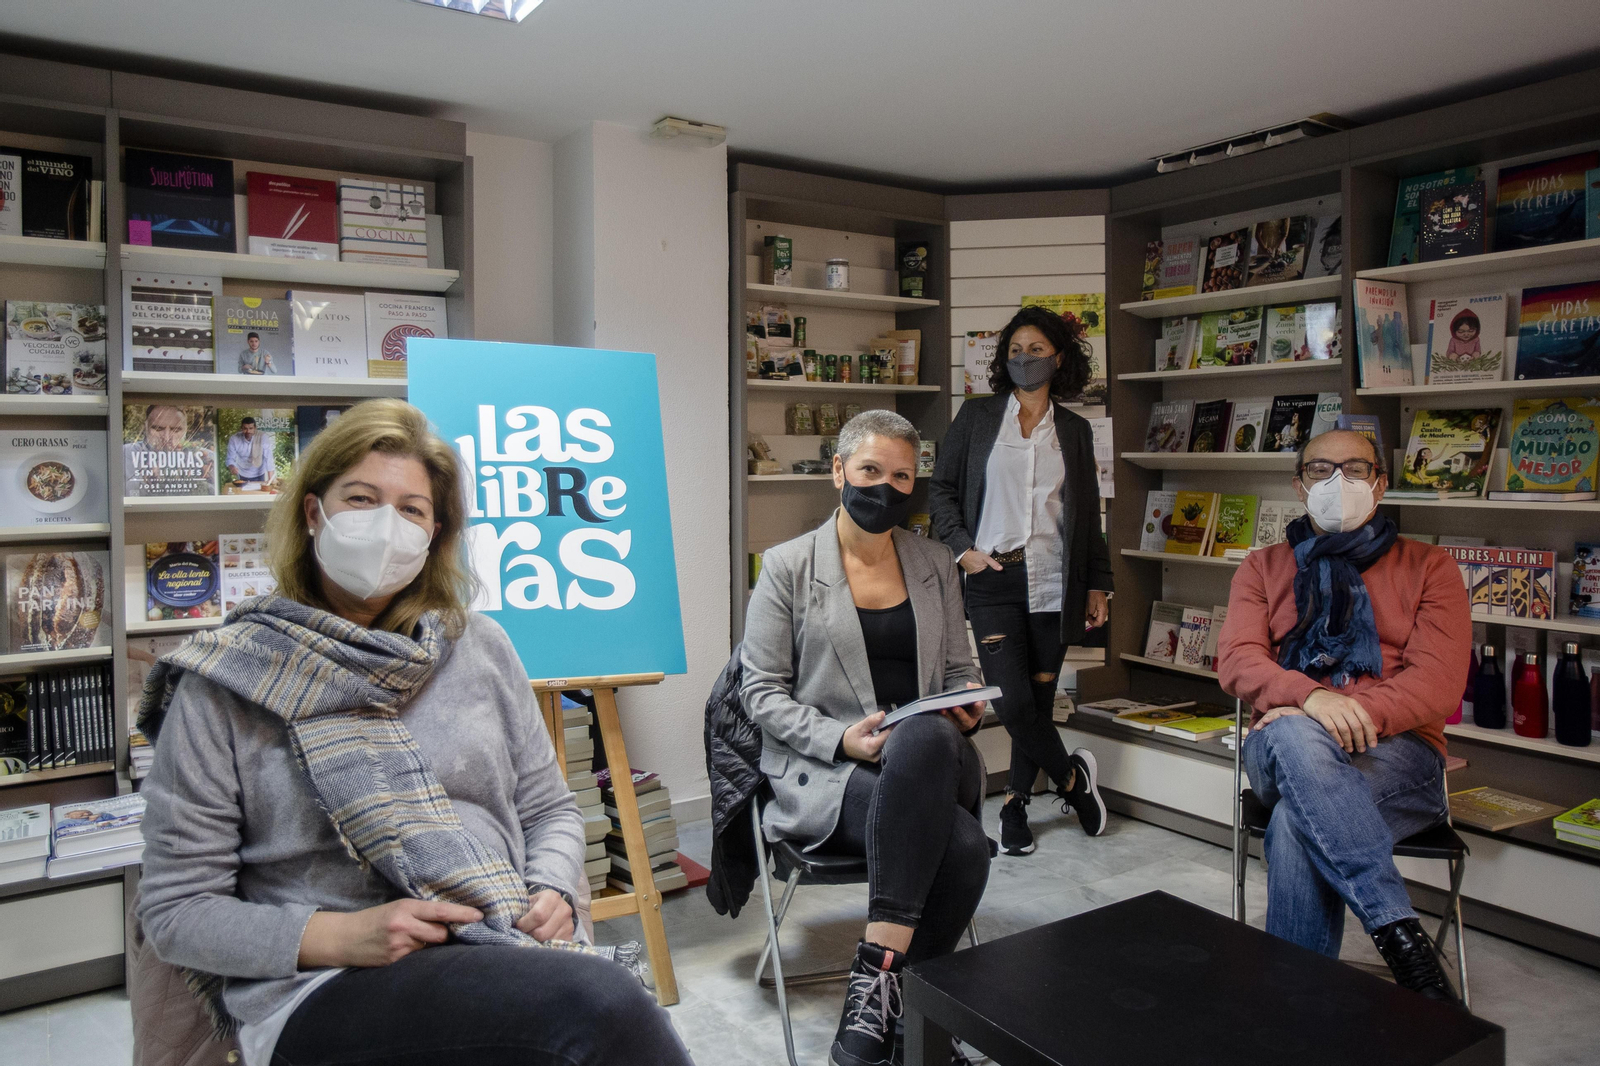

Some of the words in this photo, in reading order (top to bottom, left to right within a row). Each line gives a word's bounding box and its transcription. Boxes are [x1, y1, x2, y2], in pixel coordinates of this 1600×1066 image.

[36, 160, 74, 169] mundo
[40, 166, 74, 177] VINO
[1405, 176, 1456, 193] NOSOTROS
[1527, 174, 1564, 193] VIDAS
[1407, 200, 1417, 208] EL
[1511, 189, 1576, 214] SECRETAS
[355, 228, 416, 242] COCINA
[1168, 242, 1193, 255] SUPER
[1469, 295, 1503, 304] PANTERA
[1552, 299, 1589, 316] VIDAS
[150, 313, 212, 321] CHOCOLATERO
[227, 308, 279, 320] COCINA
[251, 319, 279, 328] HORAS
[1534, 317, 1600, 337] SECRETAS
[320, 335, 342, 343] CON
[316, 357, 349, 365] FIRMA
[1317, 403, 1342, 413] VEGAN
[1537, 412, 1577, 424] CÓMO
[1521, 426, 1561, 436] crear
[1565, 425, 1587, 434] un
[36, 438, 69, 447] GRASAS
[1516, 440, 1591, 456] MUNDO
[131, 451, 204, 469] VERDURAS
[159, 468, 202, 476] LÍMITES
[1518, 459, 1582, 477] MEJOR
[1445, 548, 1494, 563] LIBRES,
[1497, 551, 1512, 563] AL
[1516, 552, 1544, 565] FIN!
[158, 571, 170, 580] La
[171, 570, 187, 578] olla
[188, 570, 210, 578] lenta
[166, 578, 202, 589] regional
[18, 586, 54, 598] PAN
[18, 597, 96, 613] TARTINE
